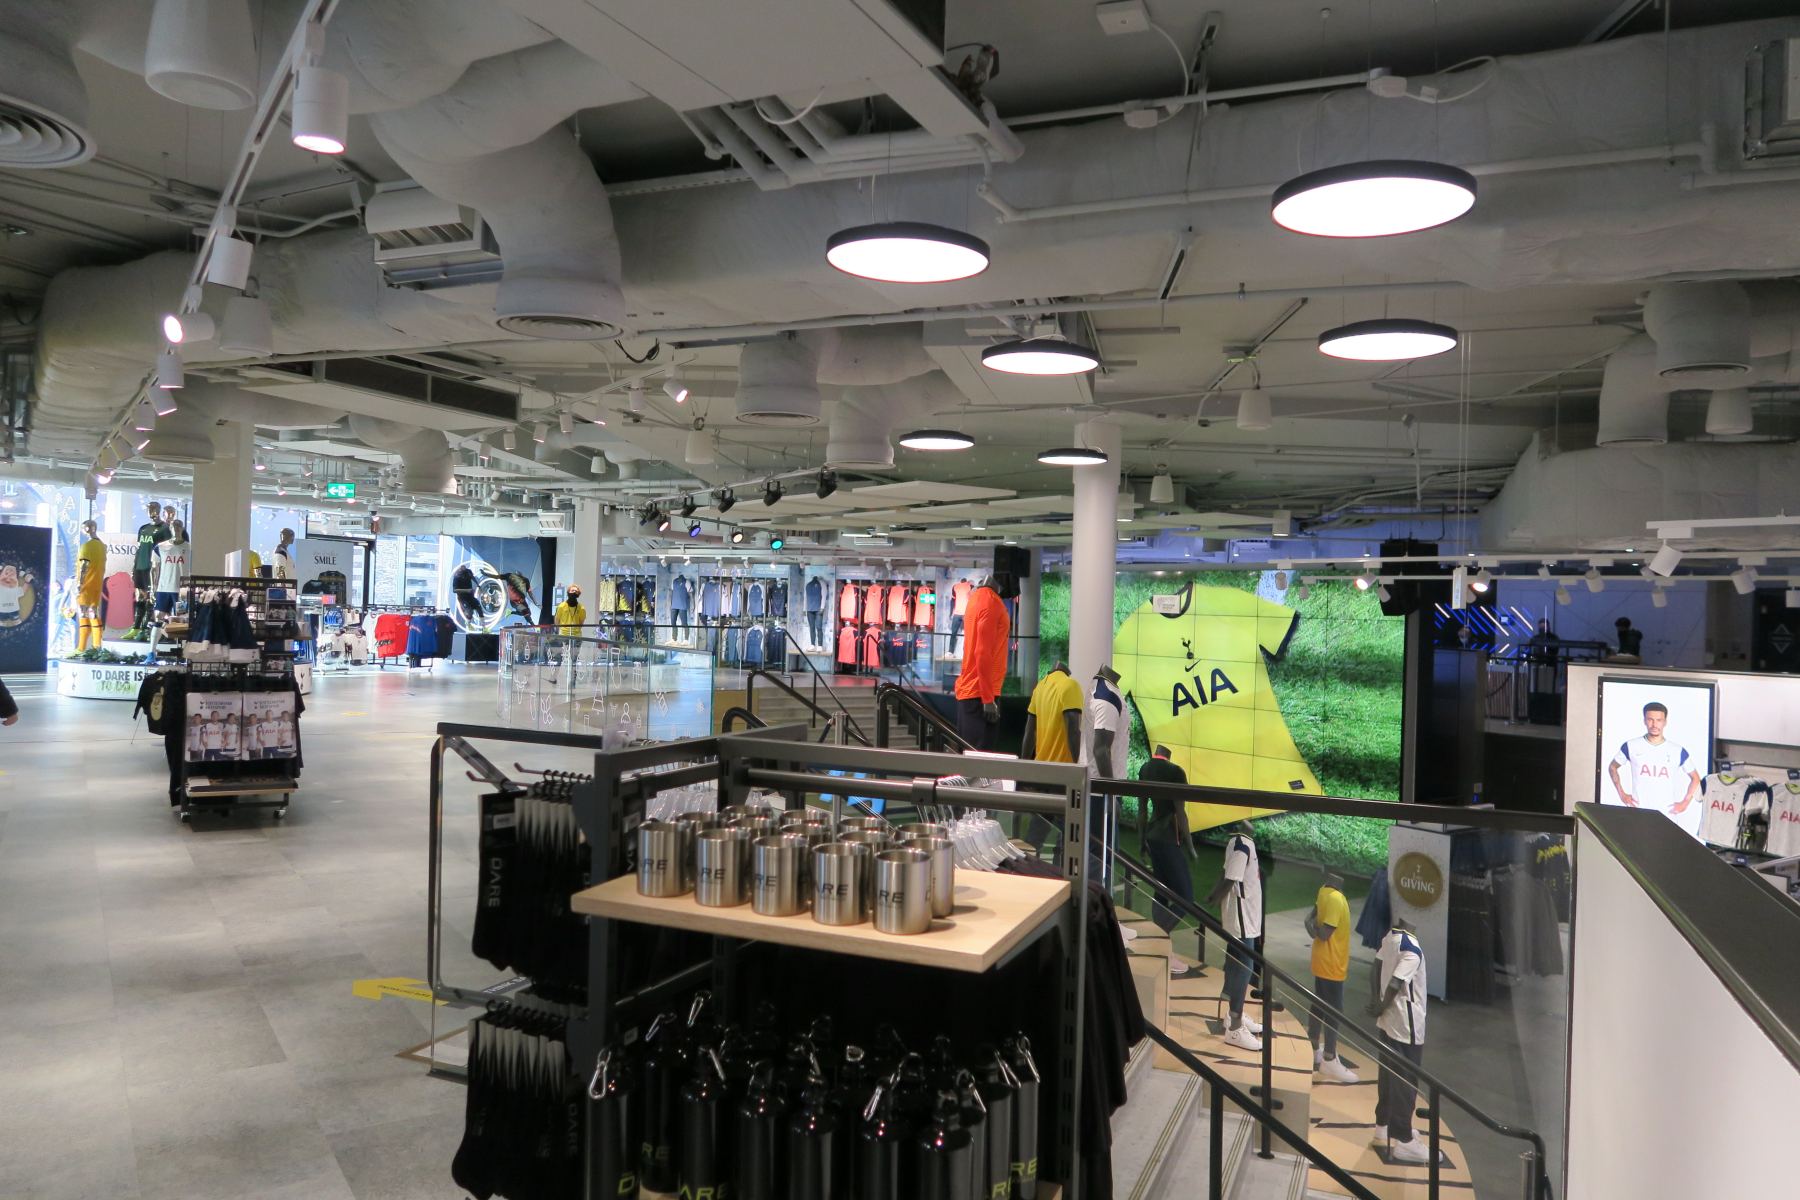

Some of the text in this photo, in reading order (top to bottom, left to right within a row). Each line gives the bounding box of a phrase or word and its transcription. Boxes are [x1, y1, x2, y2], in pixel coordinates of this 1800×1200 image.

[140, 535, 154, 544] AIA
[107, 544, 138, 556] ASSIO
[165, 555, 185, 565] AIA
[313, 555, 337, 566] SMILE
[91, 669, 144, 682] TO DARE IS
[1172, 667, 1239, 717] AIA
[1639, 763, 1670, 779] AIA
[1710, 799, 1736, 815] AIA
[642, 858, 669, 870] RE
[700, 867, 726, 880] RE
[754, 873, 778, 887] RE
[488, 857, 503, 908] DARE
[1400, 876, 1435, 895] GIVING
[879, 889, 905, 904] RE
[1010, 1157, 1038, 1176] RE
